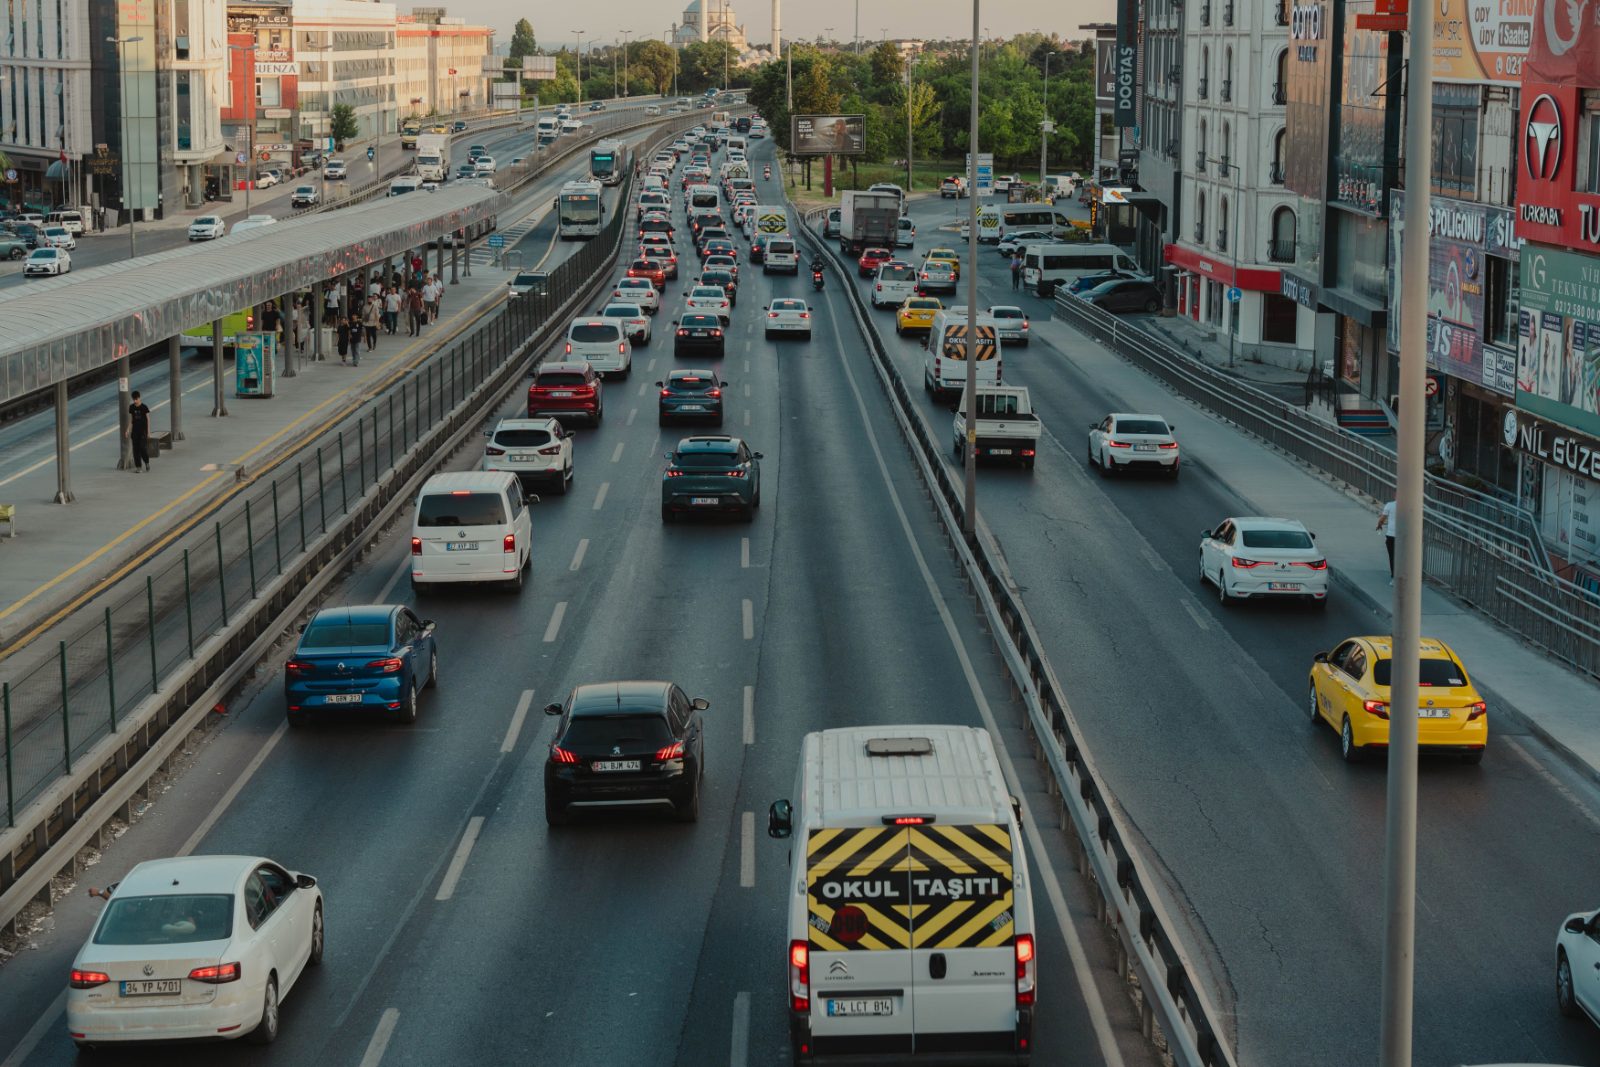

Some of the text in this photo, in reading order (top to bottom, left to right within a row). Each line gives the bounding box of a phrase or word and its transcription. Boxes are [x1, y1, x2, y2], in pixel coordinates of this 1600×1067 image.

[1475, 7, 1490, 23] ODY
[1504, 24, 1529, 46] Saatte
[1505, 56, 1527, 76] 021
[1118, 47, 1136, 110] DOĞTAŞ
[1496, 212, 1526, 250] SİL
[1551, 278, 1589, 301] TEKNİK
[1520, 421, 1548, 458] NİL
[626, 761, 639, 769] 474
[822, 878, 999, 900] OKUL TAŞITI
[126, 981, 178, 993] 34 YP 4701
[834, 1000, 890, 1013] 34 LCT 814
